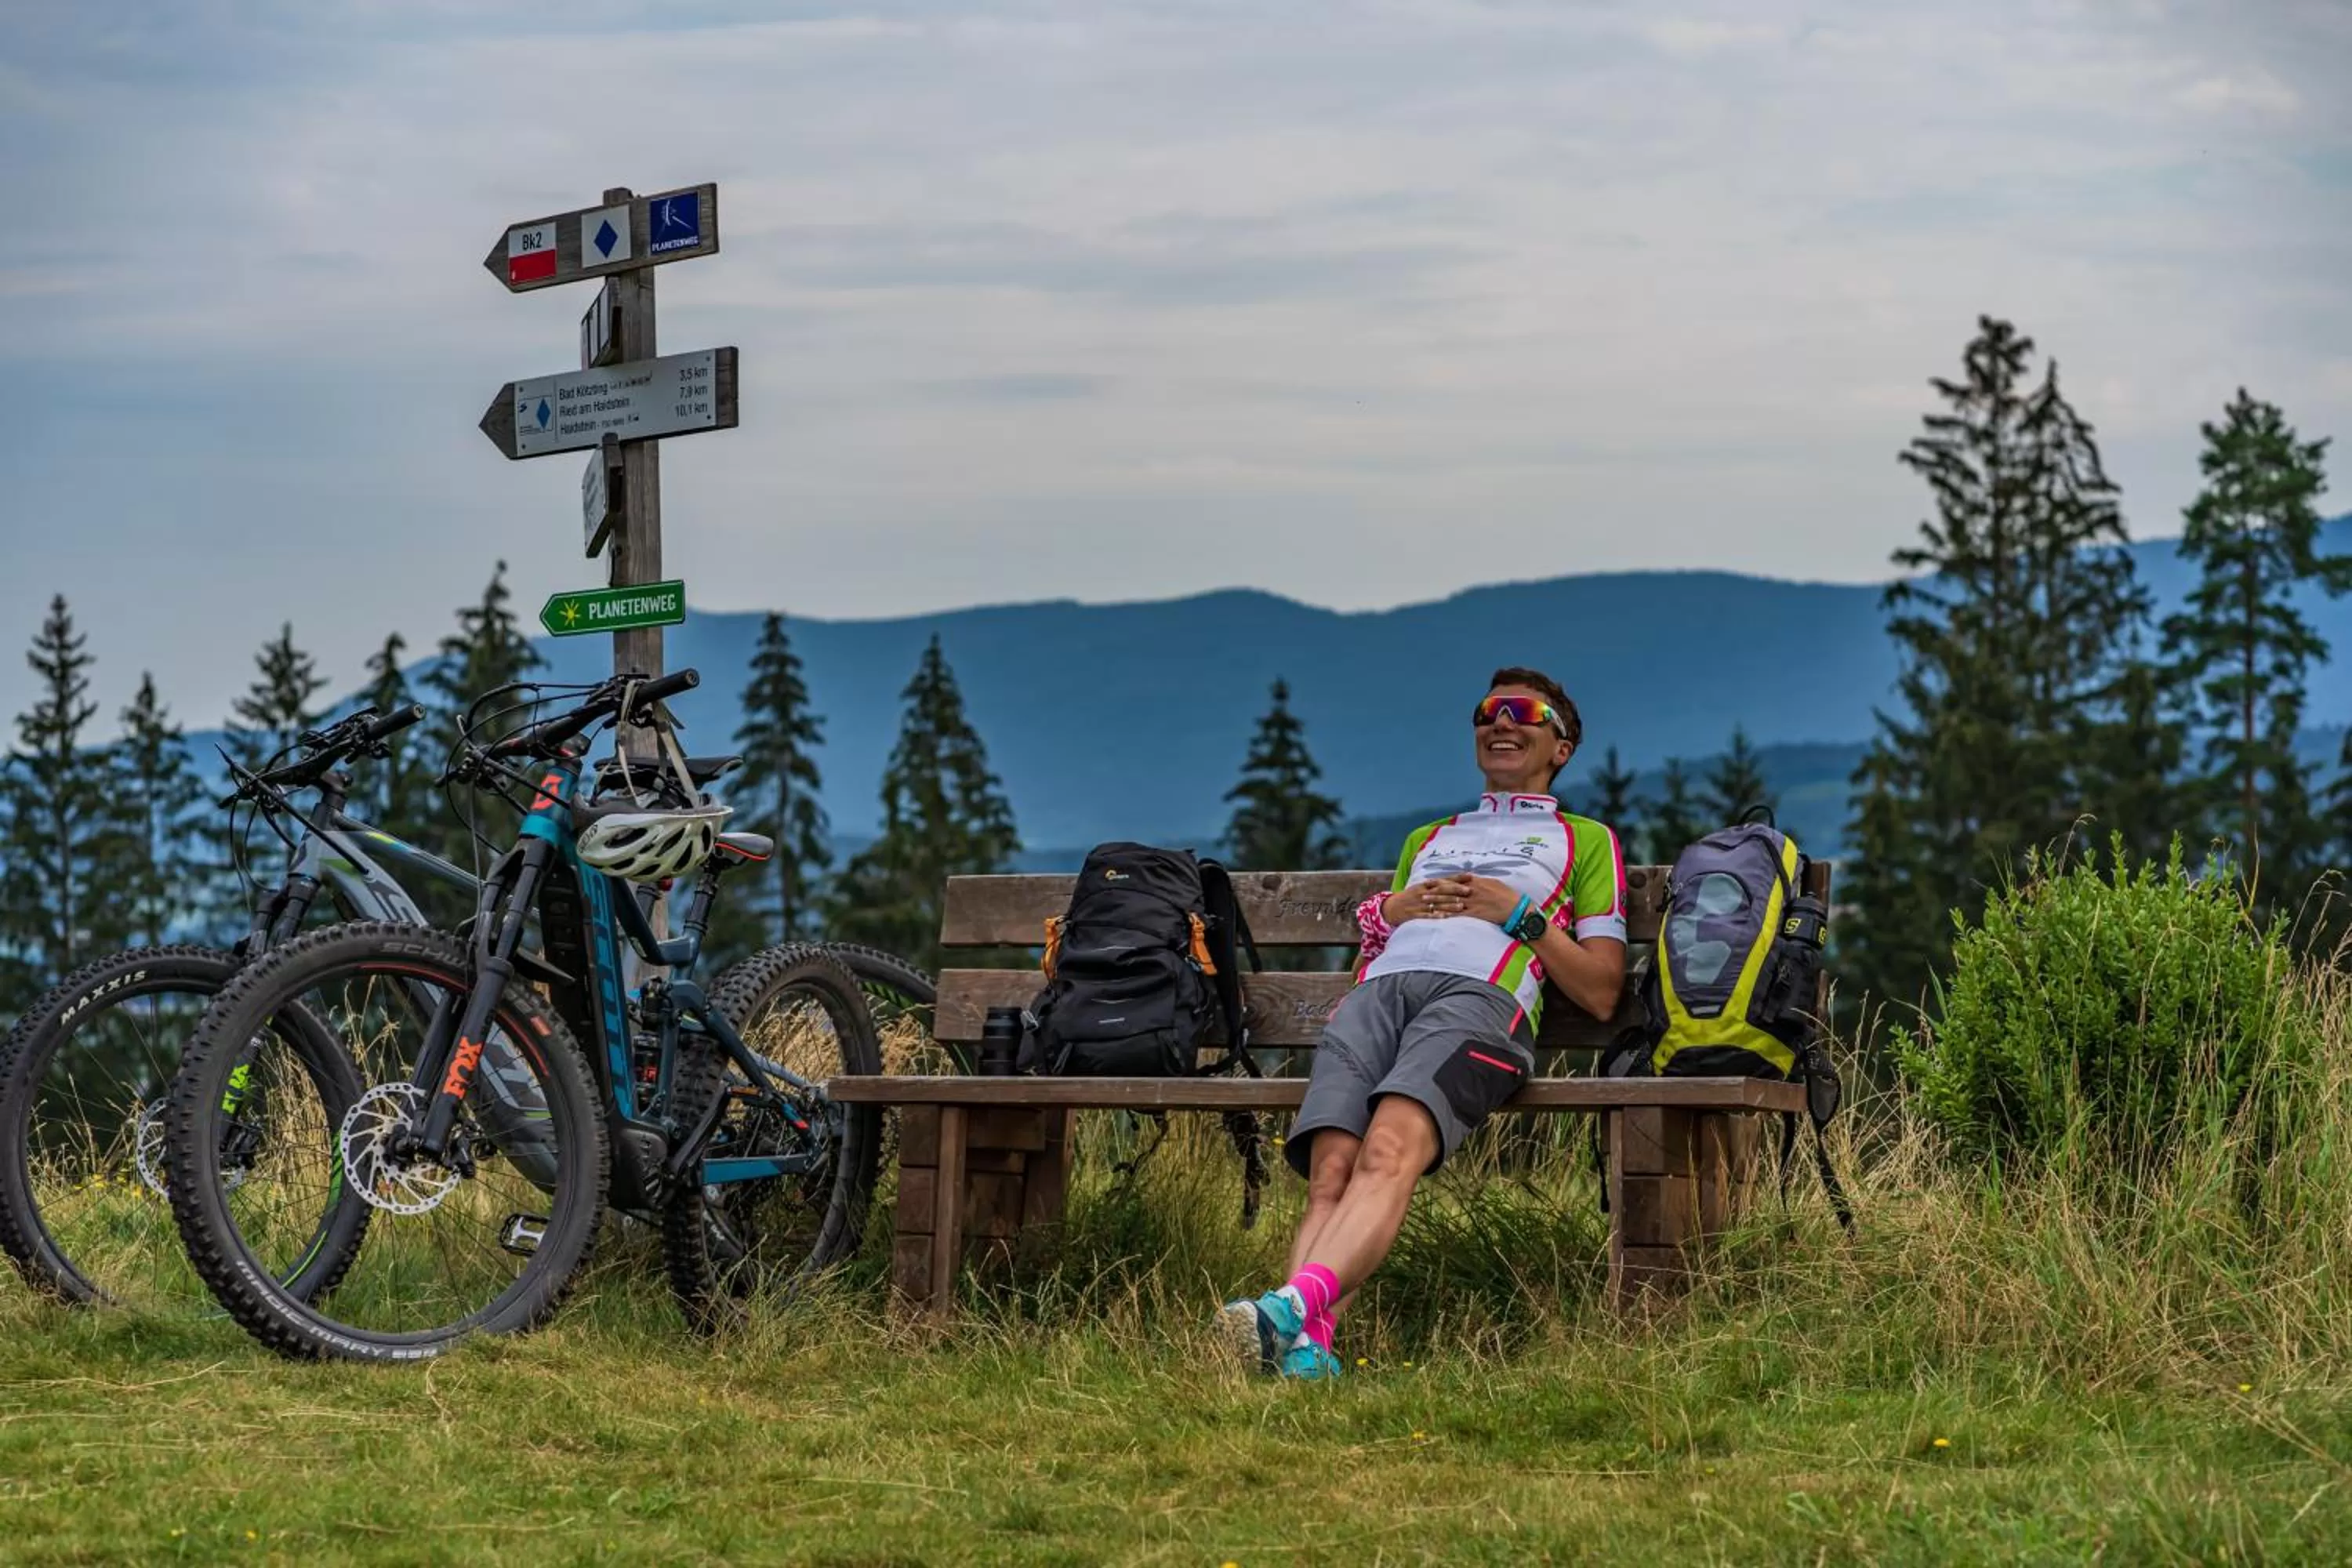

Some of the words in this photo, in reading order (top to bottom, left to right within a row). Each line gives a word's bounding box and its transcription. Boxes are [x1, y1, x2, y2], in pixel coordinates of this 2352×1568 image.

[523, 231, 542, 250] Bk2
[695, 367, 708, 379] km
[695, 385, 708, 396] km
[695, 402, 708, 415] km
[589, 594, 676, 620] PLANETENWEG
[61, 970, 147, 1025] MAXXIS
[442, 1036, 484, 1099] FOX
